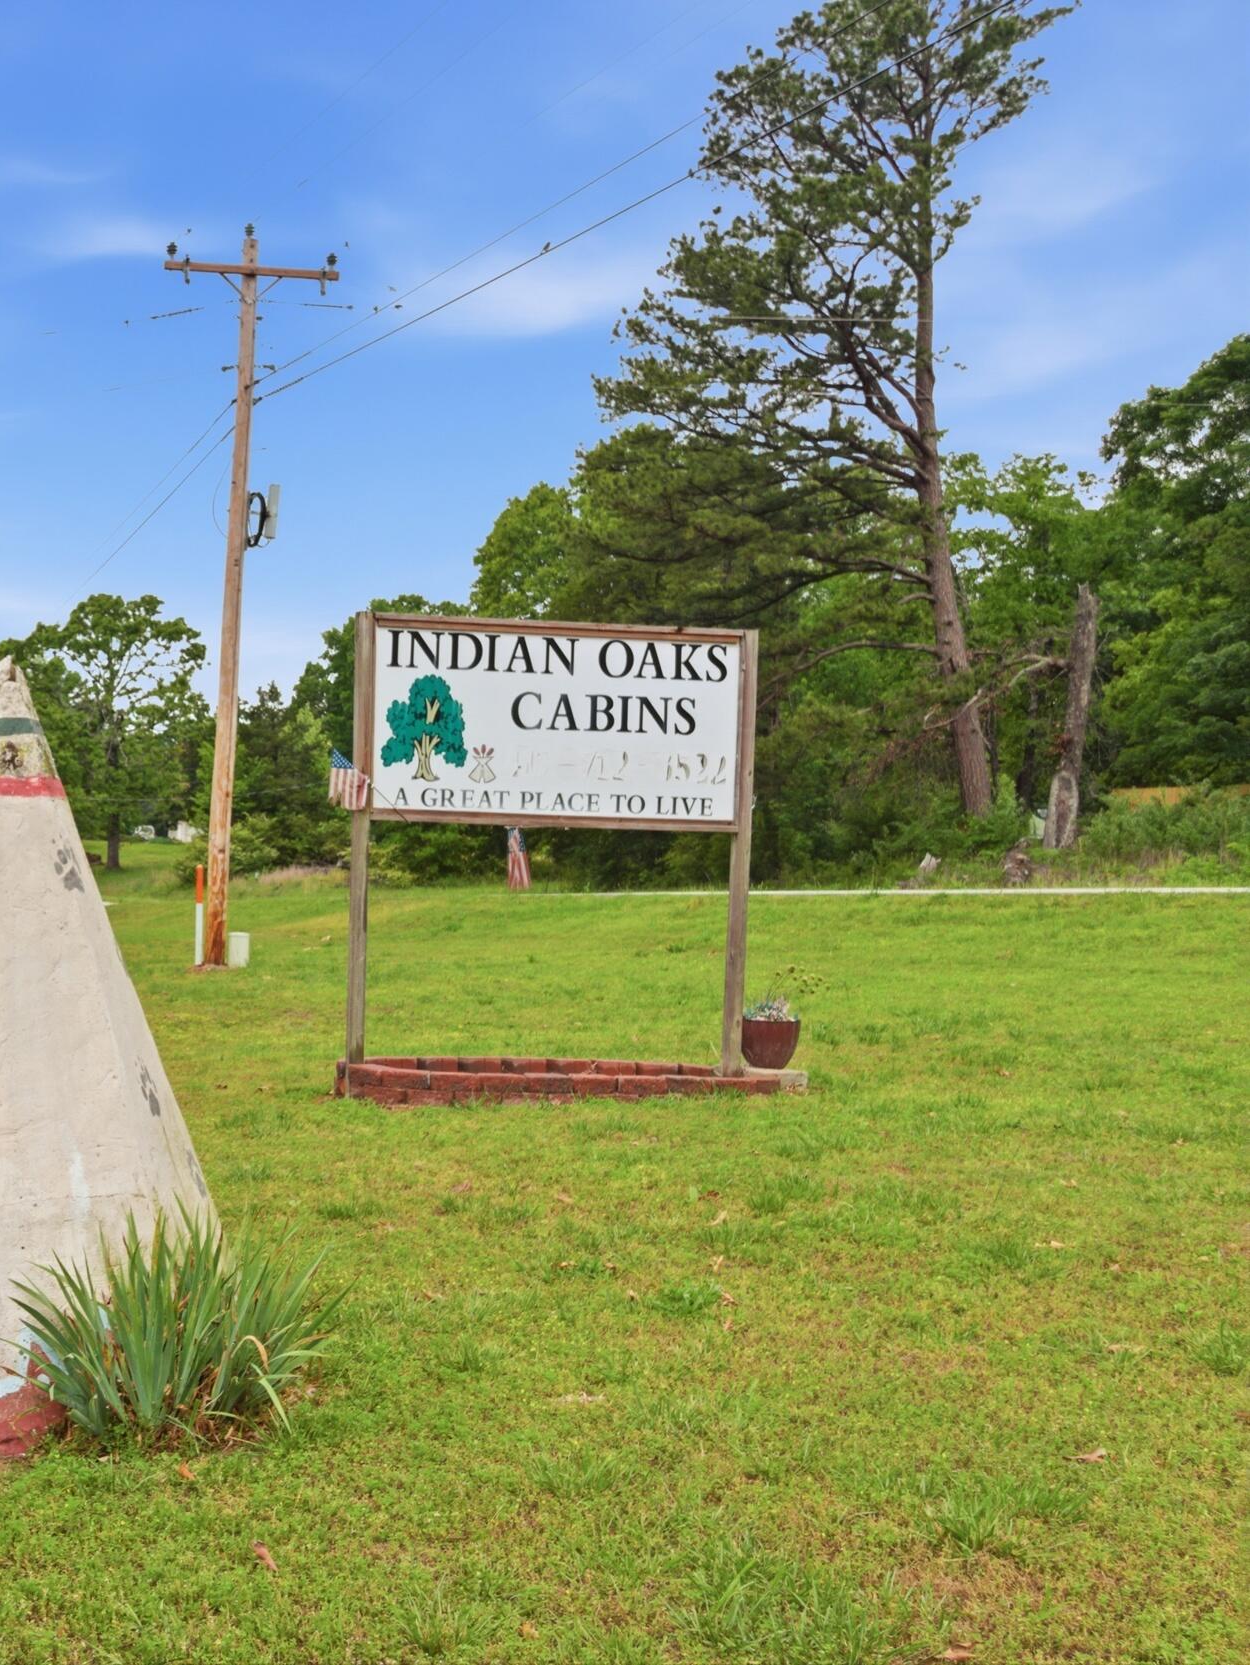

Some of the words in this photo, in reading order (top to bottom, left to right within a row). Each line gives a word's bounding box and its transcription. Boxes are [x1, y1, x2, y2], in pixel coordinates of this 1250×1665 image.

[386, 629, 580, 677] INDIAN
[598, 638, 729, 683] OAKS
[510, 691, 697, 736] CABINS
[393, 787, 409, 807] A
[420, 787, 511, 810] GREAT
[519, 791, 600, 813] PLACE
[610, 793, 646, 815] TO
[655, 795, 714, 817] LIVE
